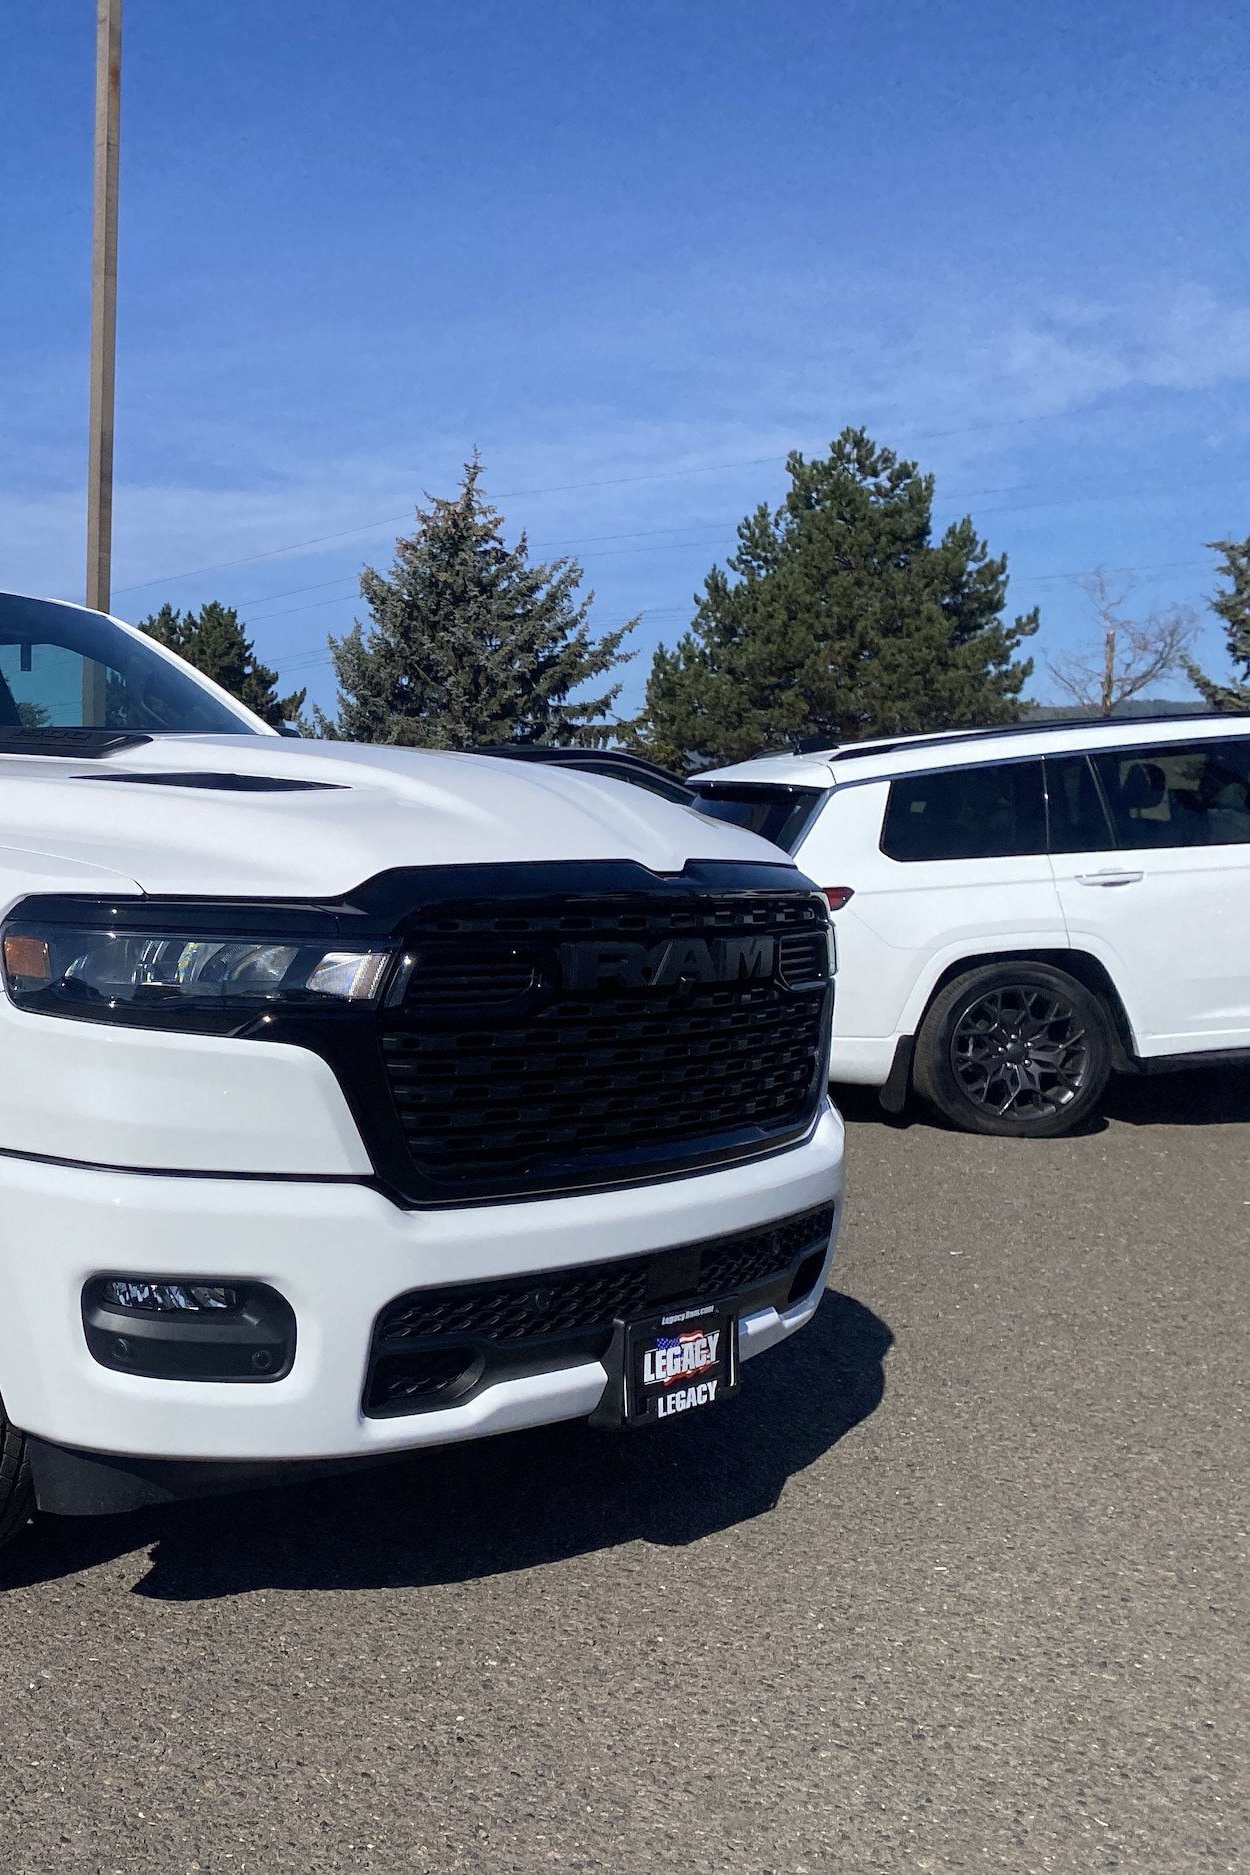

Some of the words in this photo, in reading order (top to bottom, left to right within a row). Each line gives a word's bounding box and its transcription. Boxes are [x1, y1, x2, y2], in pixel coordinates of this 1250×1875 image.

[558, 936, 774, 990] RAM
[644, 1332, 720, 1383] LEGACY
[657, 1379, 718, 1419] LEGACY
